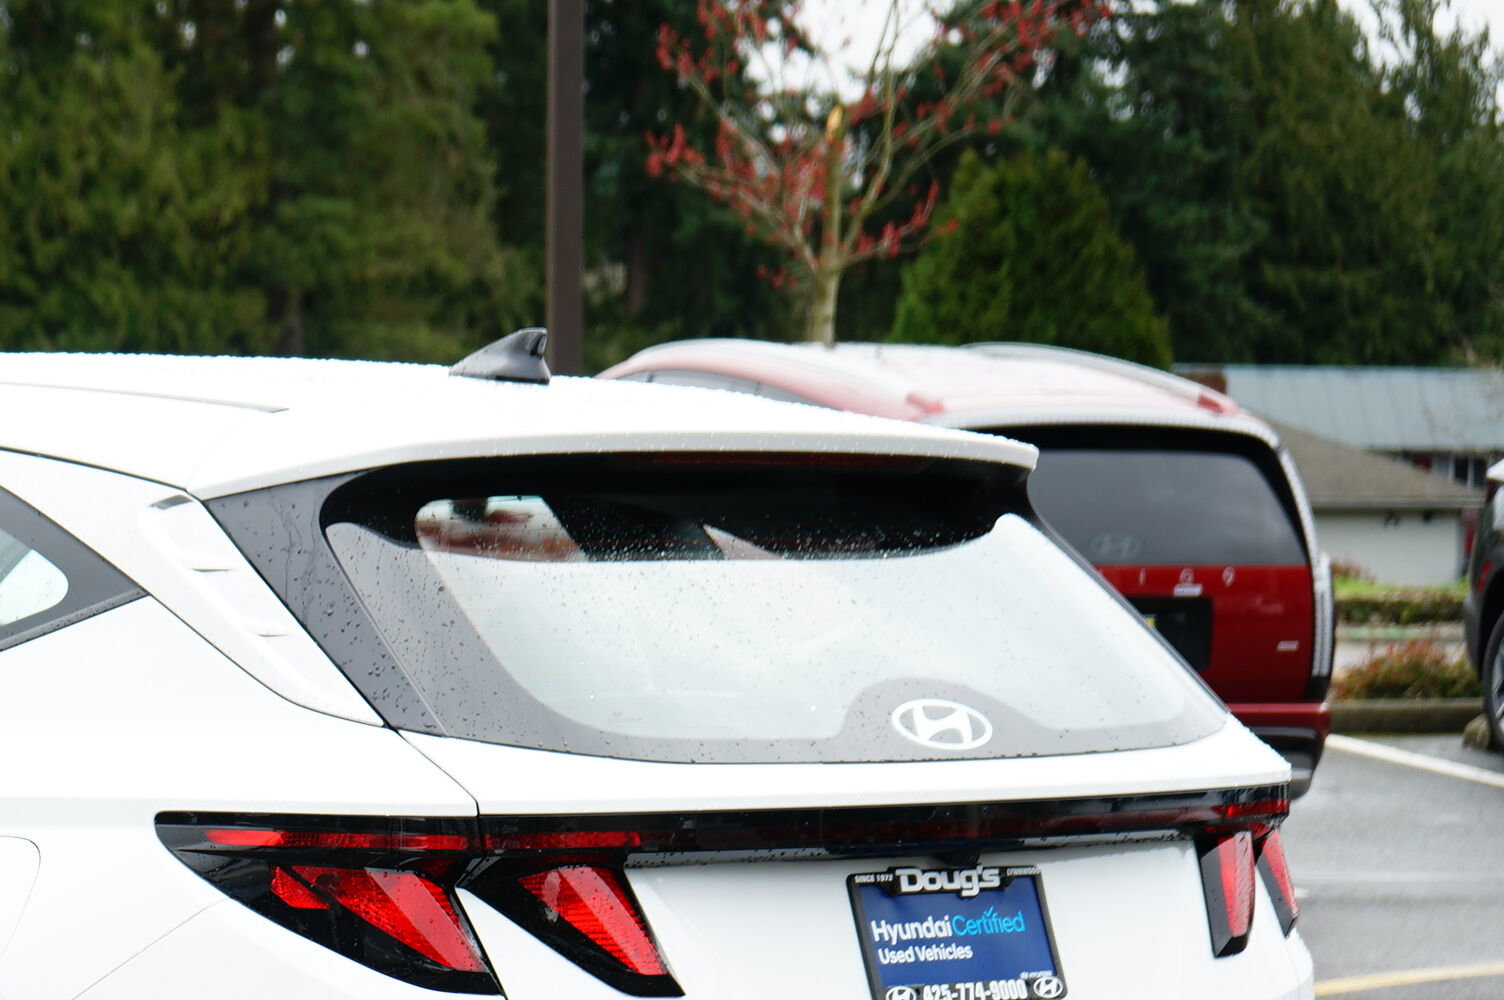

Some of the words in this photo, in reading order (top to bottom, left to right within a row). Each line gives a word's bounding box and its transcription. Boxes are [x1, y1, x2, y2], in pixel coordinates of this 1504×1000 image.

[895, 865, 1001, 897] Doug's
[878, 946, 915, 965] Used
[914, 942, 973, 962] Vehicles
